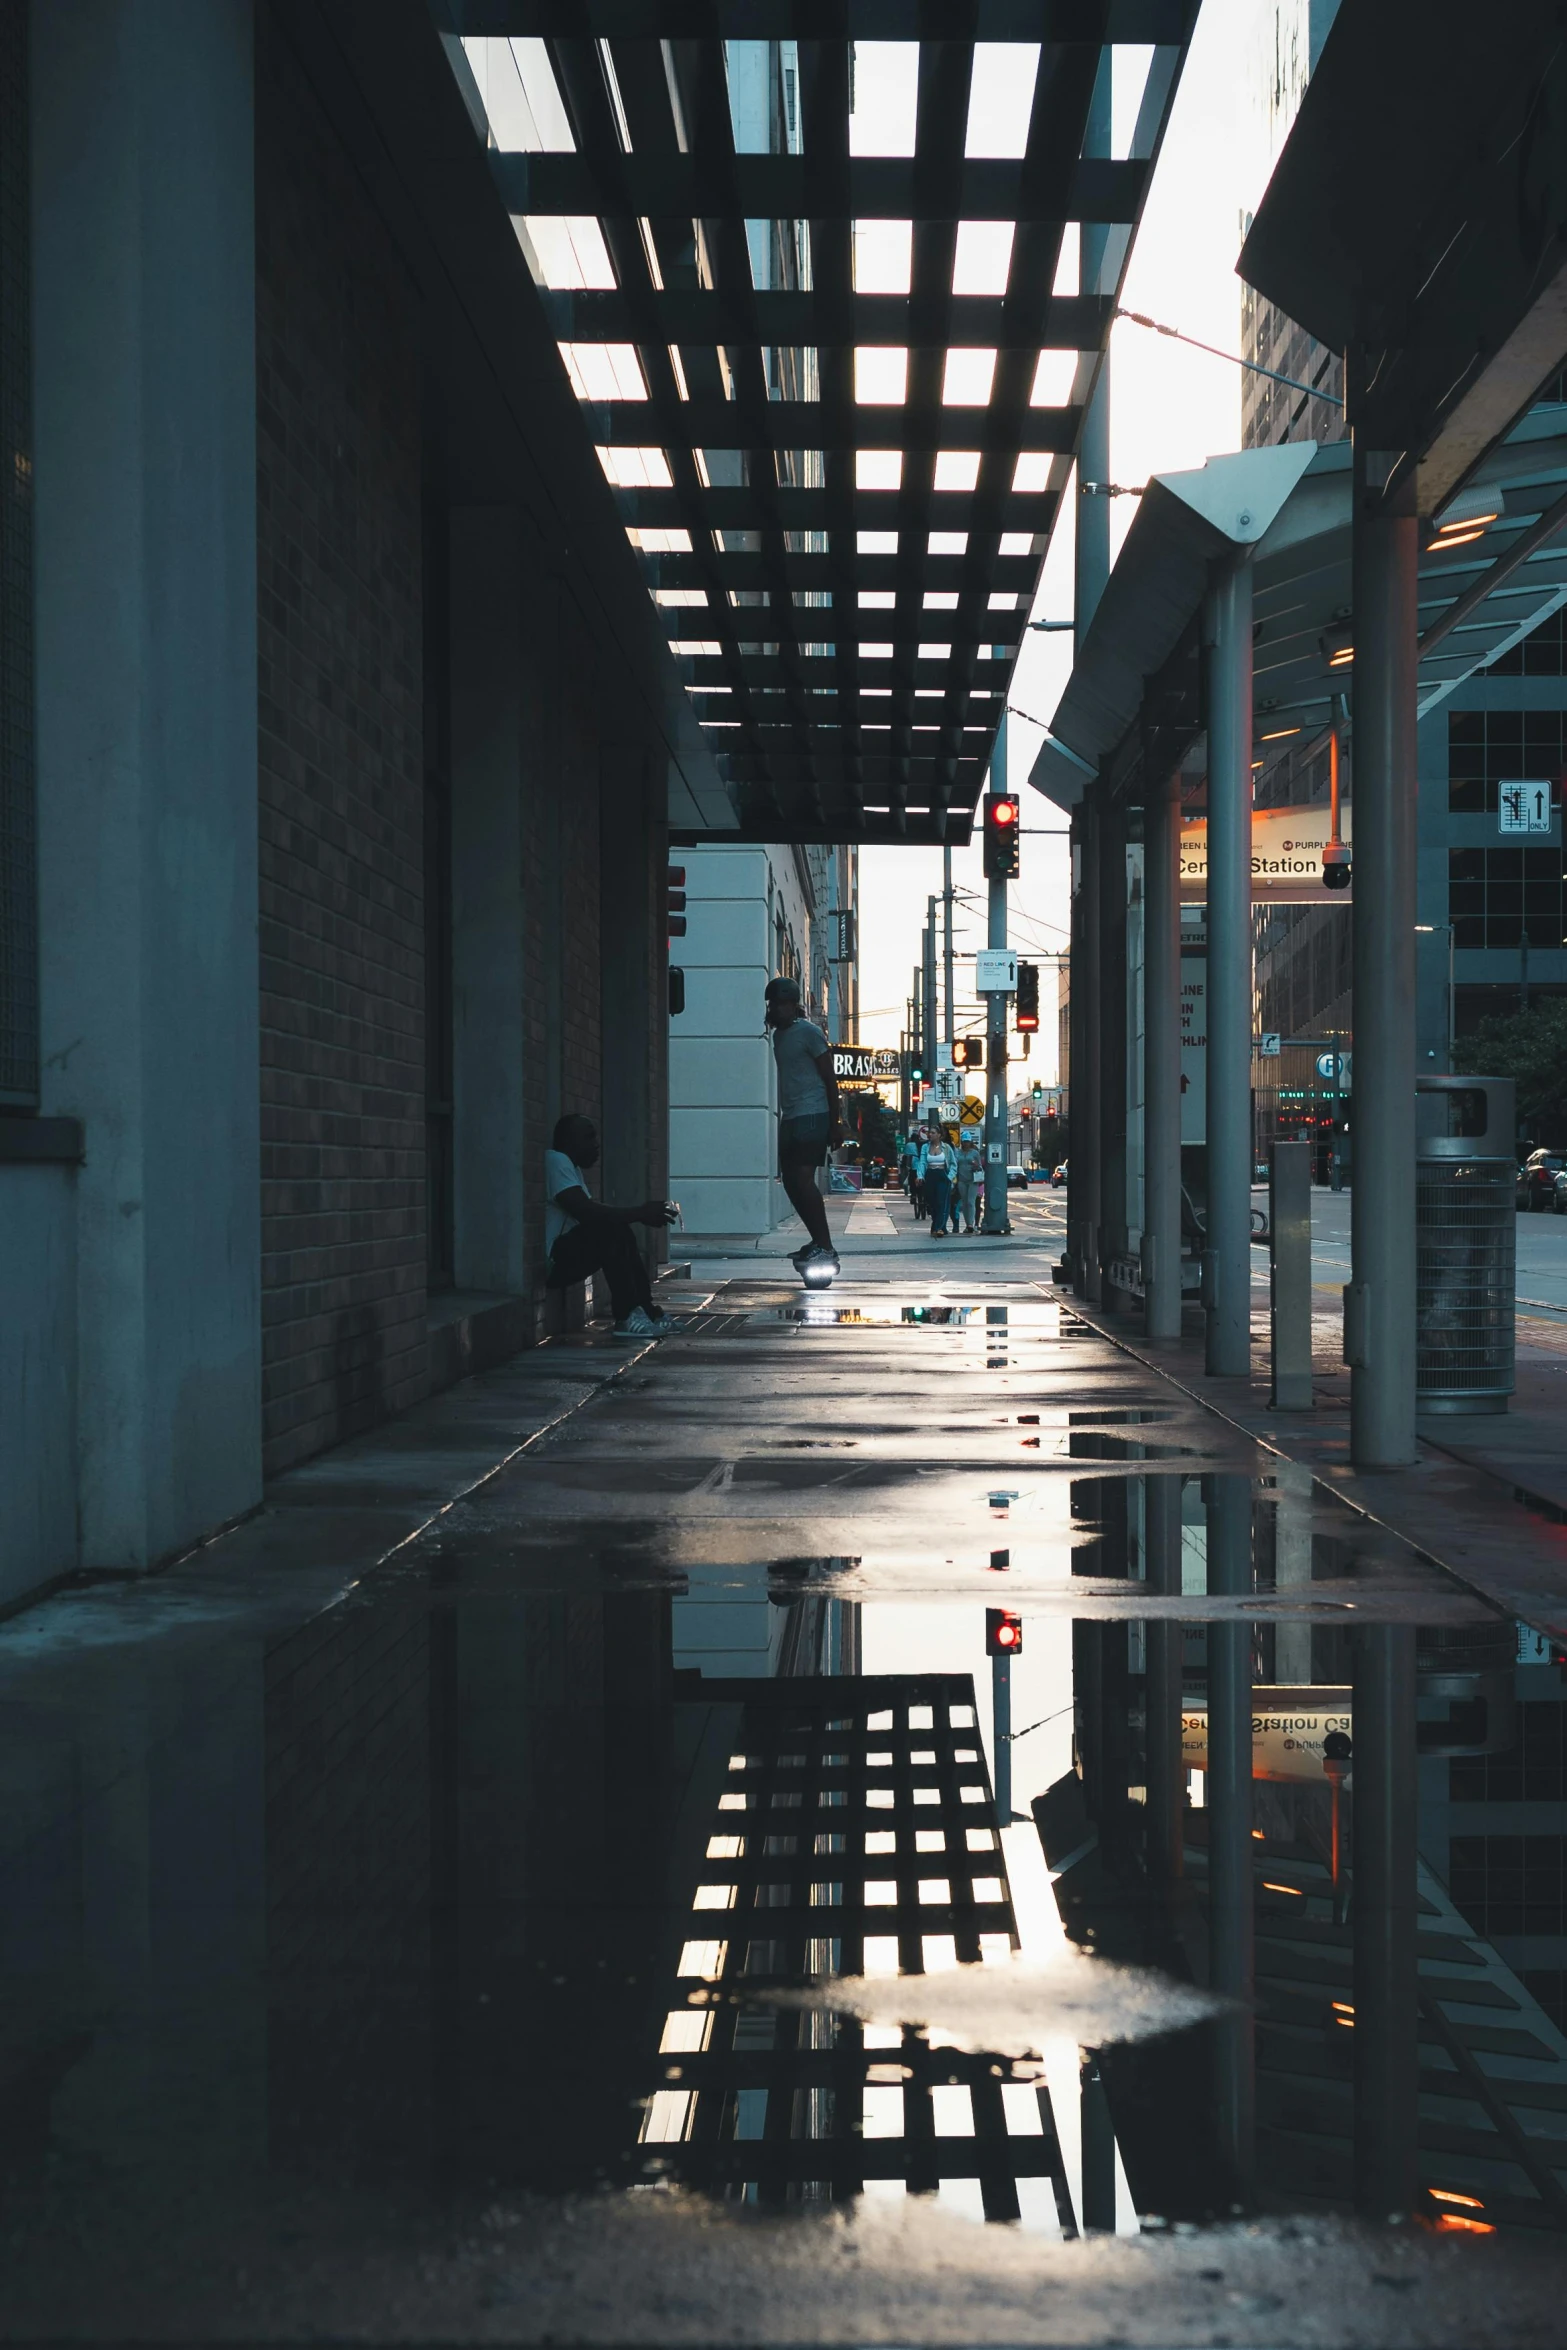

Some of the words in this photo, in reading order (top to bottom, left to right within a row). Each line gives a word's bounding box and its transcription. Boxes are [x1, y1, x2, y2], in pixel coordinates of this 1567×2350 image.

[1530, 822, 1548, 830] ONLY
[1251, 857, 1316, 873] Station
[945, 1107, 956, 1117] 10
